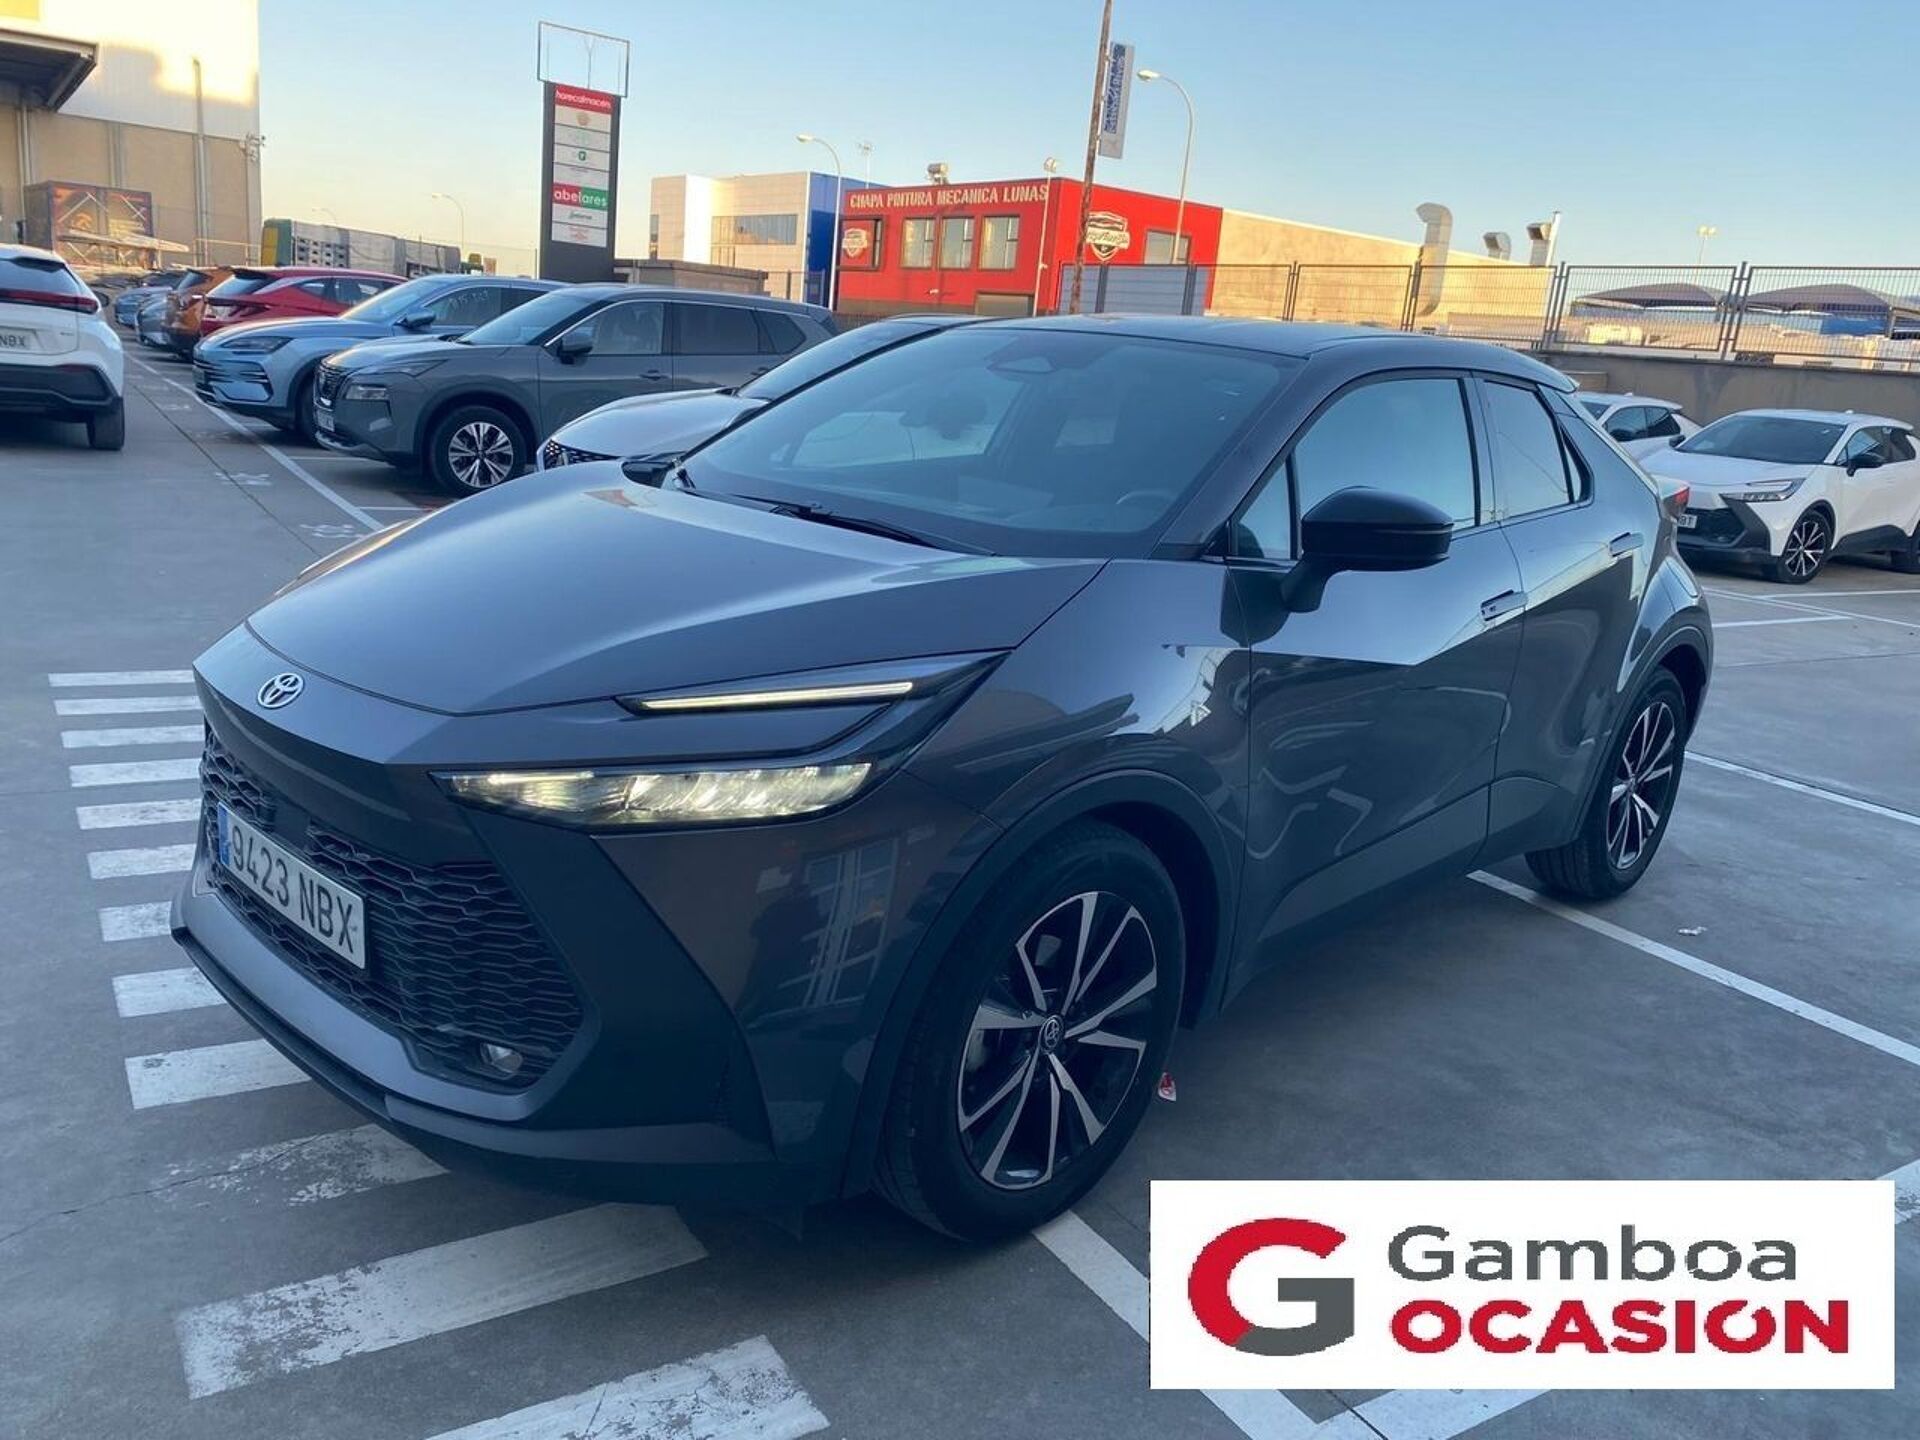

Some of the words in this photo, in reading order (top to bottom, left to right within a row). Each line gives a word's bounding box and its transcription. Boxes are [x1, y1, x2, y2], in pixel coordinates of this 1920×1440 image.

[850, 193, 884, 208] CHAPA
[887, 191, 932, 207] PINTURA
[937, 188, 998, 205] MECANICA
[1003, 184, 1048, 203] LUNAS
[232, 826, 290, 907] 9423
[300, 871, 353, 954] NBX
